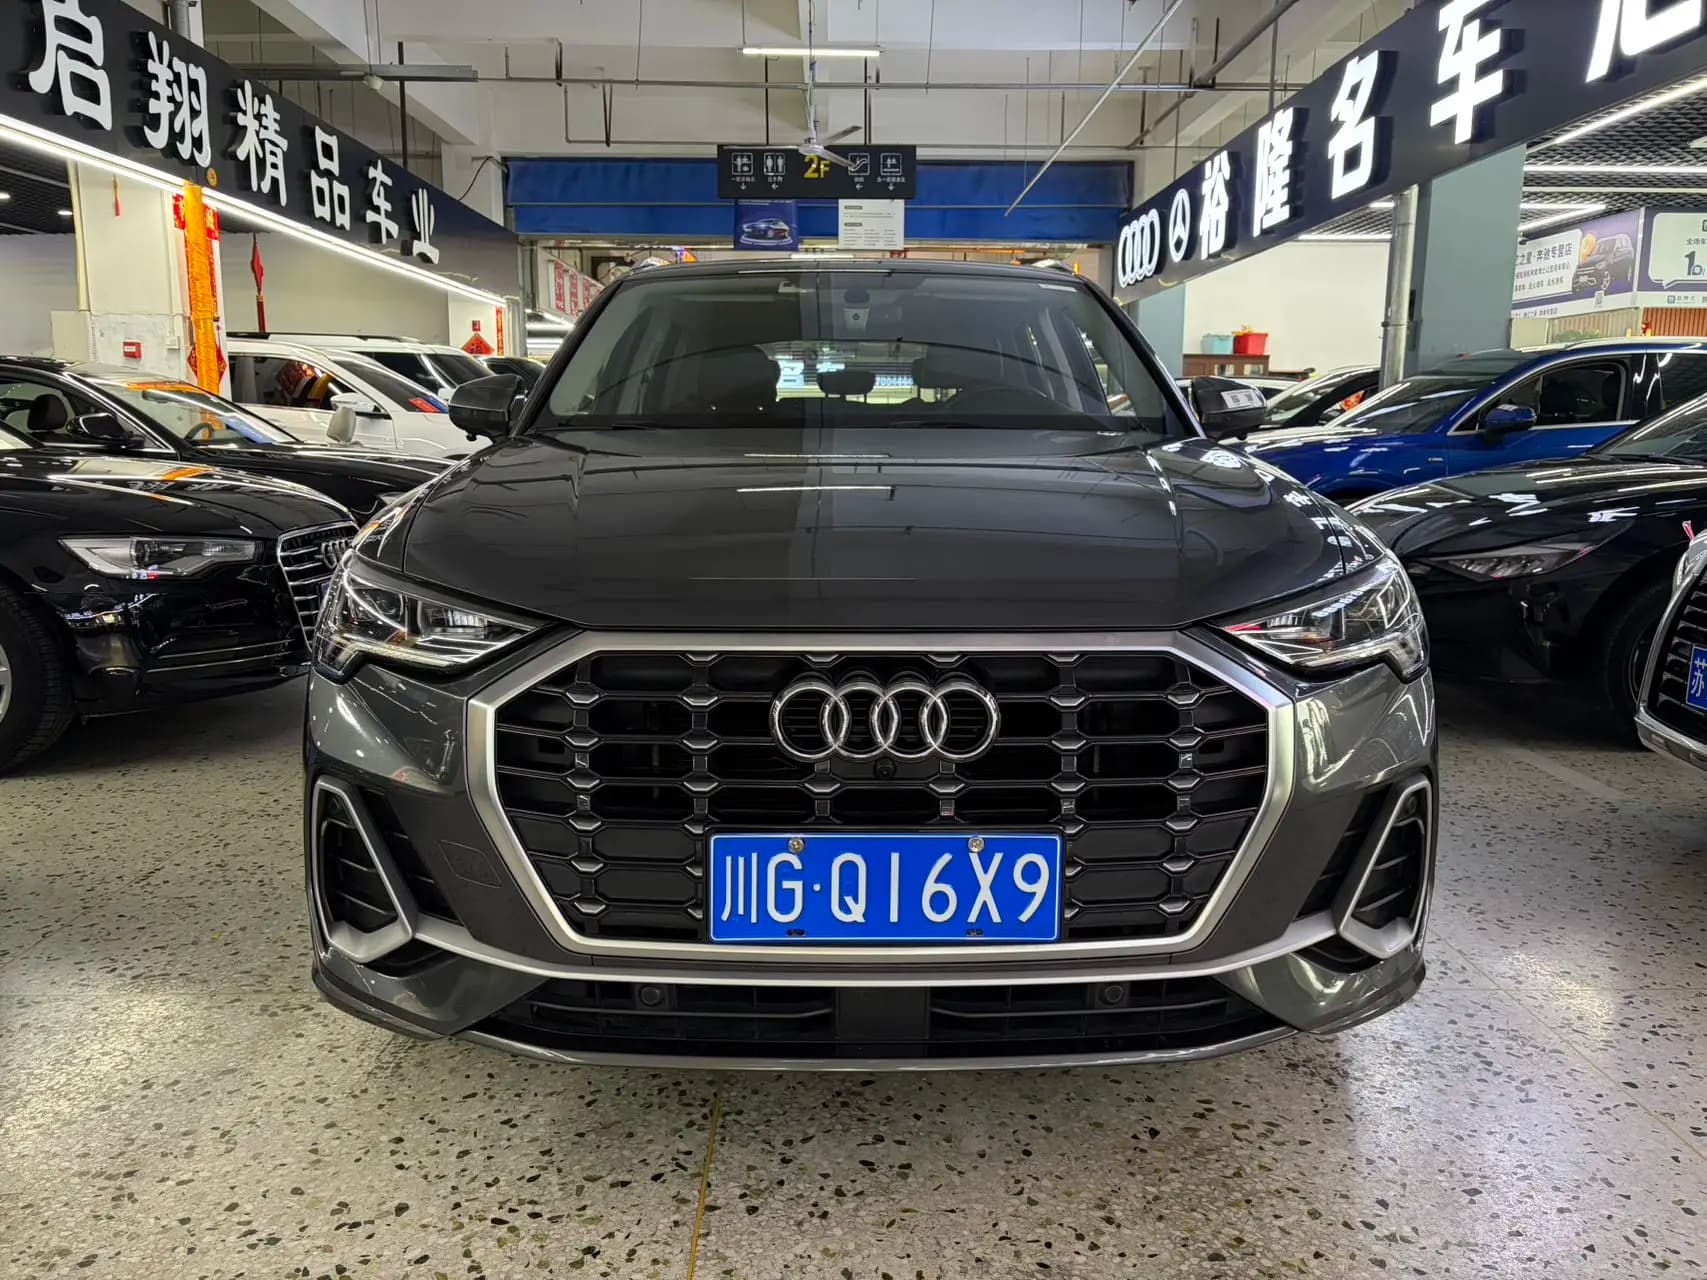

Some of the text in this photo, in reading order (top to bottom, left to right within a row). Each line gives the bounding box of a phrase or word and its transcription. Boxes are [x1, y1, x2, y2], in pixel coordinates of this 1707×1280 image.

[29, 0, 440, 264] 启翔精品车业
[803, 154, 831, 179] 2F
[721, 851, 1050, 923] 川G·Q16X9
